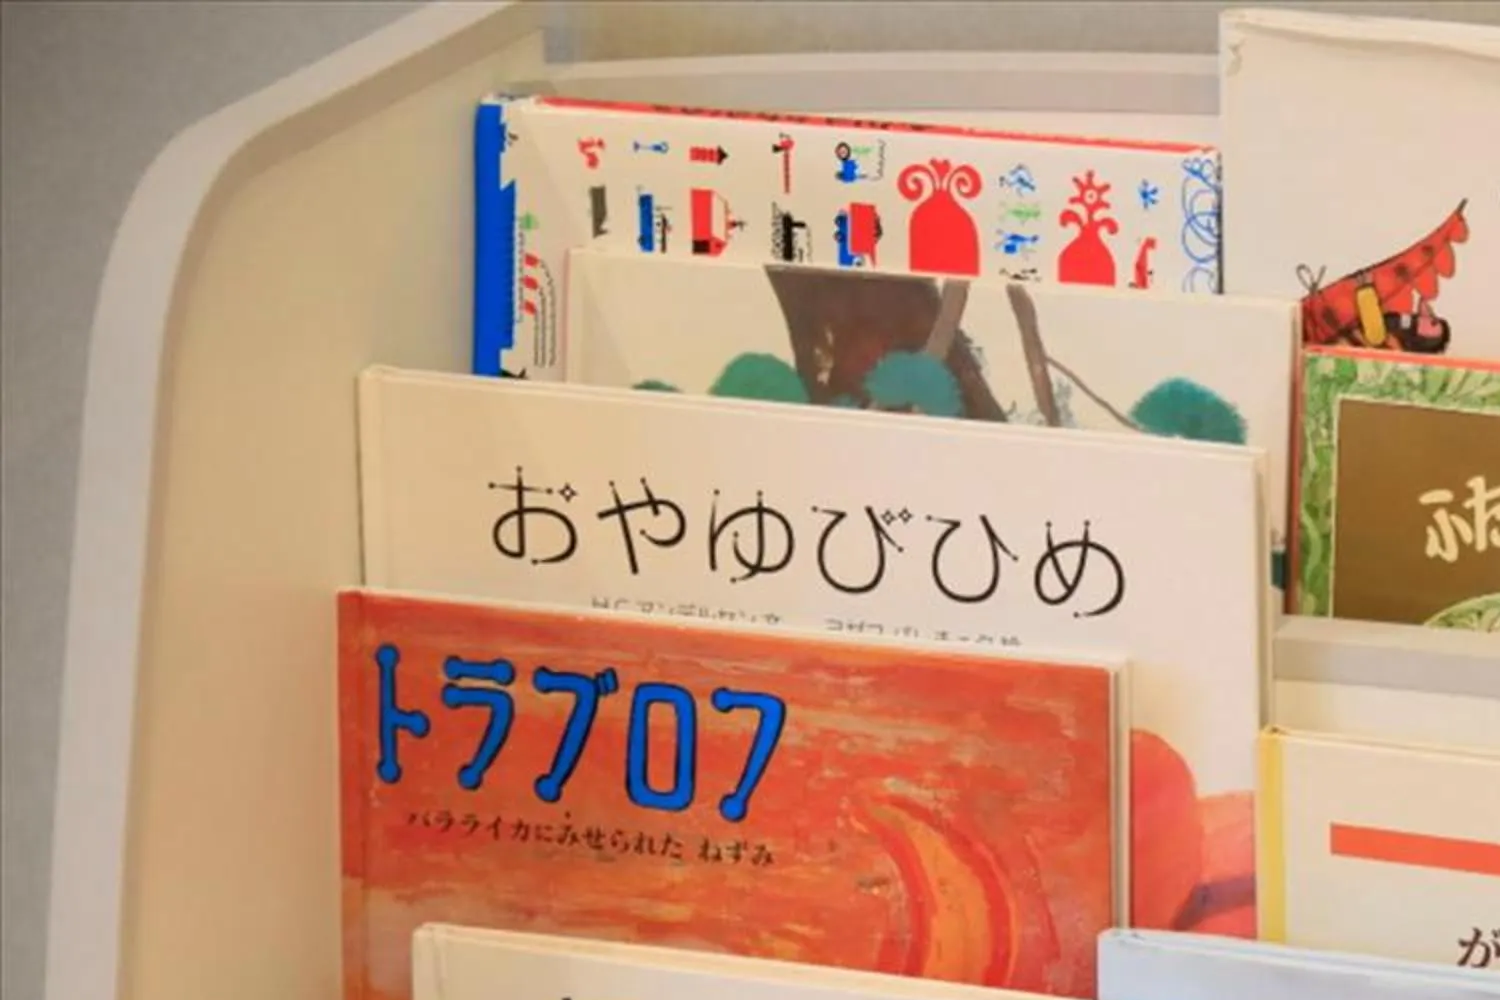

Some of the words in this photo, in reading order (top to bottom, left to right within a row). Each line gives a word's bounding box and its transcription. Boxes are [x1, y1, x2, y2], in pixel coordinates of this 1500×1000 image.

[489, 466, 1125, 618] おやゆびひめ
[375, 643, 786, 823] トラブロフ
[697, 839, 776, 868] ねずみ
